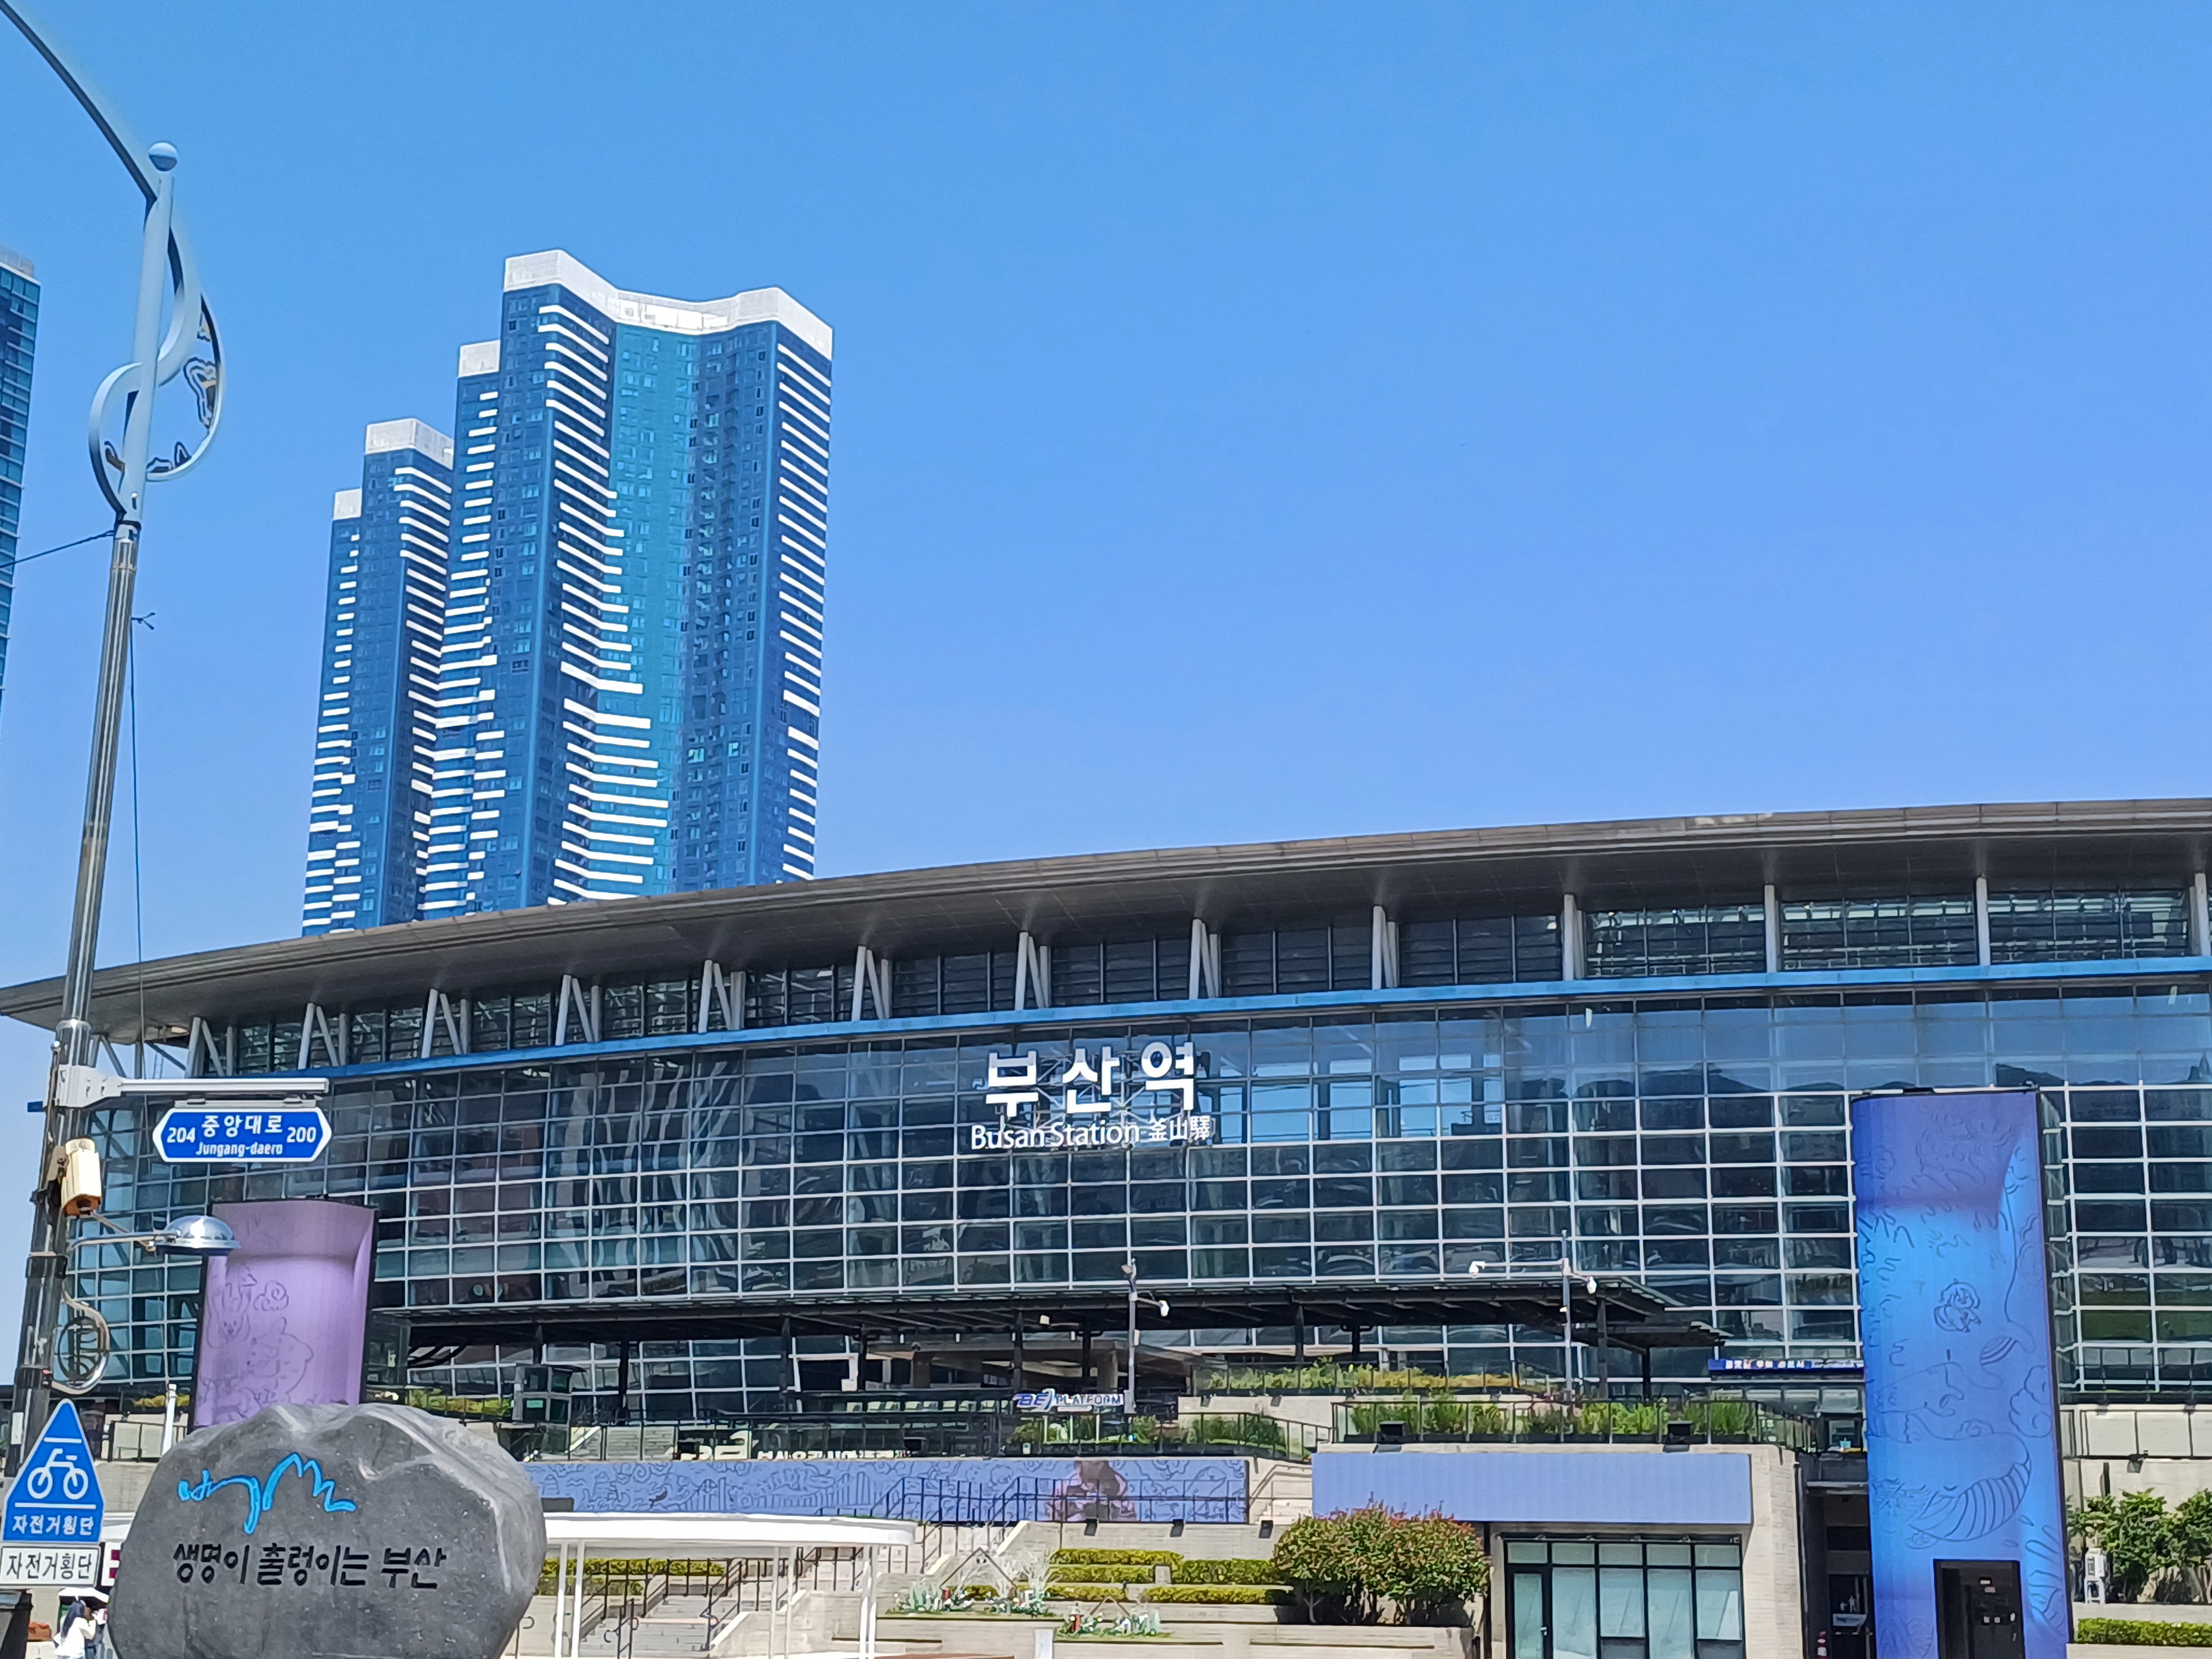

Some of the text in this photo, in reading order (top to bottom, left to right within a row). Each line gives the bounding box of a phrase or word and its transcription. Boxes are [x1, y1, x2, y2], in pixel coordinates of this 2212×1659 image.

[986, 1042, 1194, 1117] 부산역
[166, 1115, 317, 1143] 204 중앙대로 200
[971, 1115, 1211, 1150] Busan Station 釜山驛
[195, 1141, 283, 1157] Jungang-daero
[12, 1514, 94, 1536] 자전거횡단
[6, 1552, 92, 1581] 자전거횡단
[173, 1543, 251, 1585] 생명이
[257, 1542, 369, 1587] 출렁이는
[380, 1547, 447, 1589] 부산
